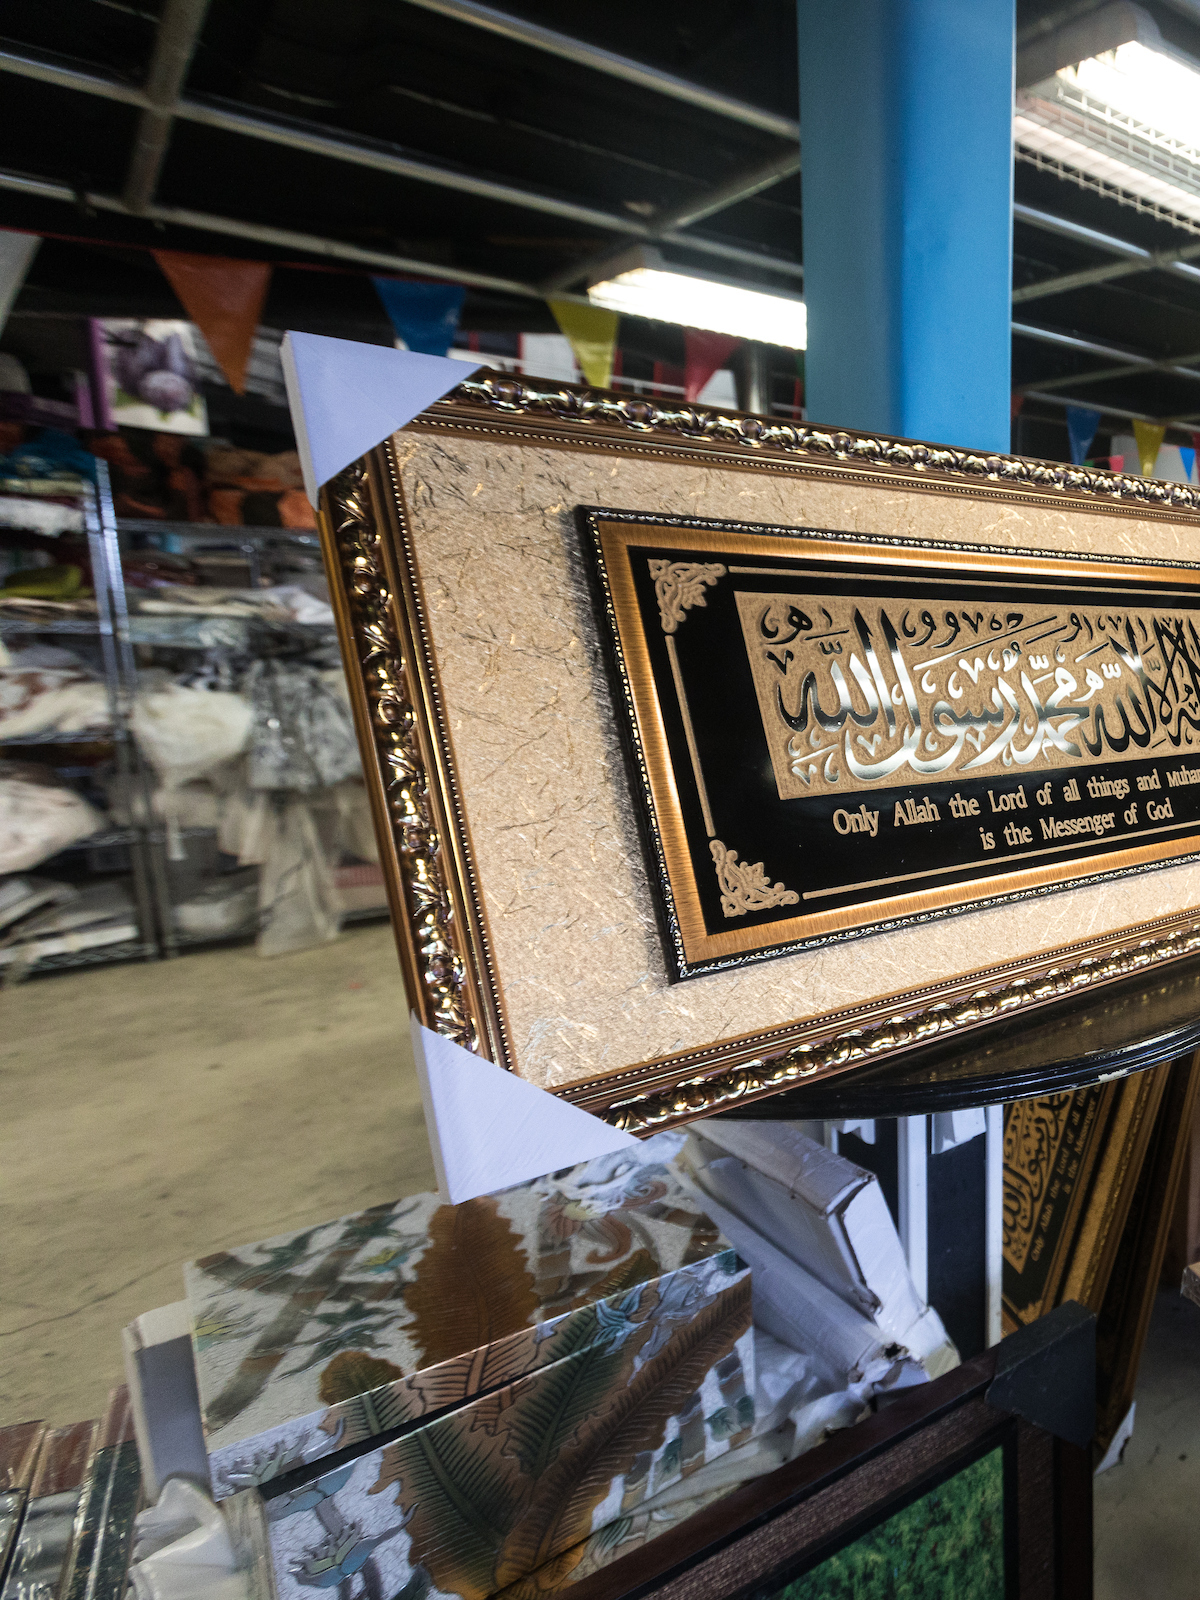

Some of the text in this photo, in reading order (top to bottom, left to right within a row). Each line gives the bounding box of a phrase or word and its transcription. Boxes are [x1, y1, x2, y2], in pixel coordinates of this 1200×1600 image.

[832, 804, 879, 837] Only
[893, 797, 941, 827] Allah
[949, 794, 980, 818] the
[988, 787, 1027, 813] Lord
[1036, 783, 1053, 806] of
[1063, 778, 1080, 802] all
[1087, 774, 1130, 800] things
[1137, 769, 1160, 791] and
[979, 797, 1174, 850] is the Messenger of God
[1031, 1234, 1046, 1262] Only
[1040, 1203, 1054, 1233] Allah
[1050, 1178, 1061, 1199] the
[1056, 1147, 1070, 1175] Lord
[1066, 1127, 1075, 1145] of
[1071, 1110, 1081, 1126] all
[1062, 1182, 1072, 1195] is
[1067, 1159, 1079, 1180] the
[1074, 1097, 1097, 1155] Messenger
